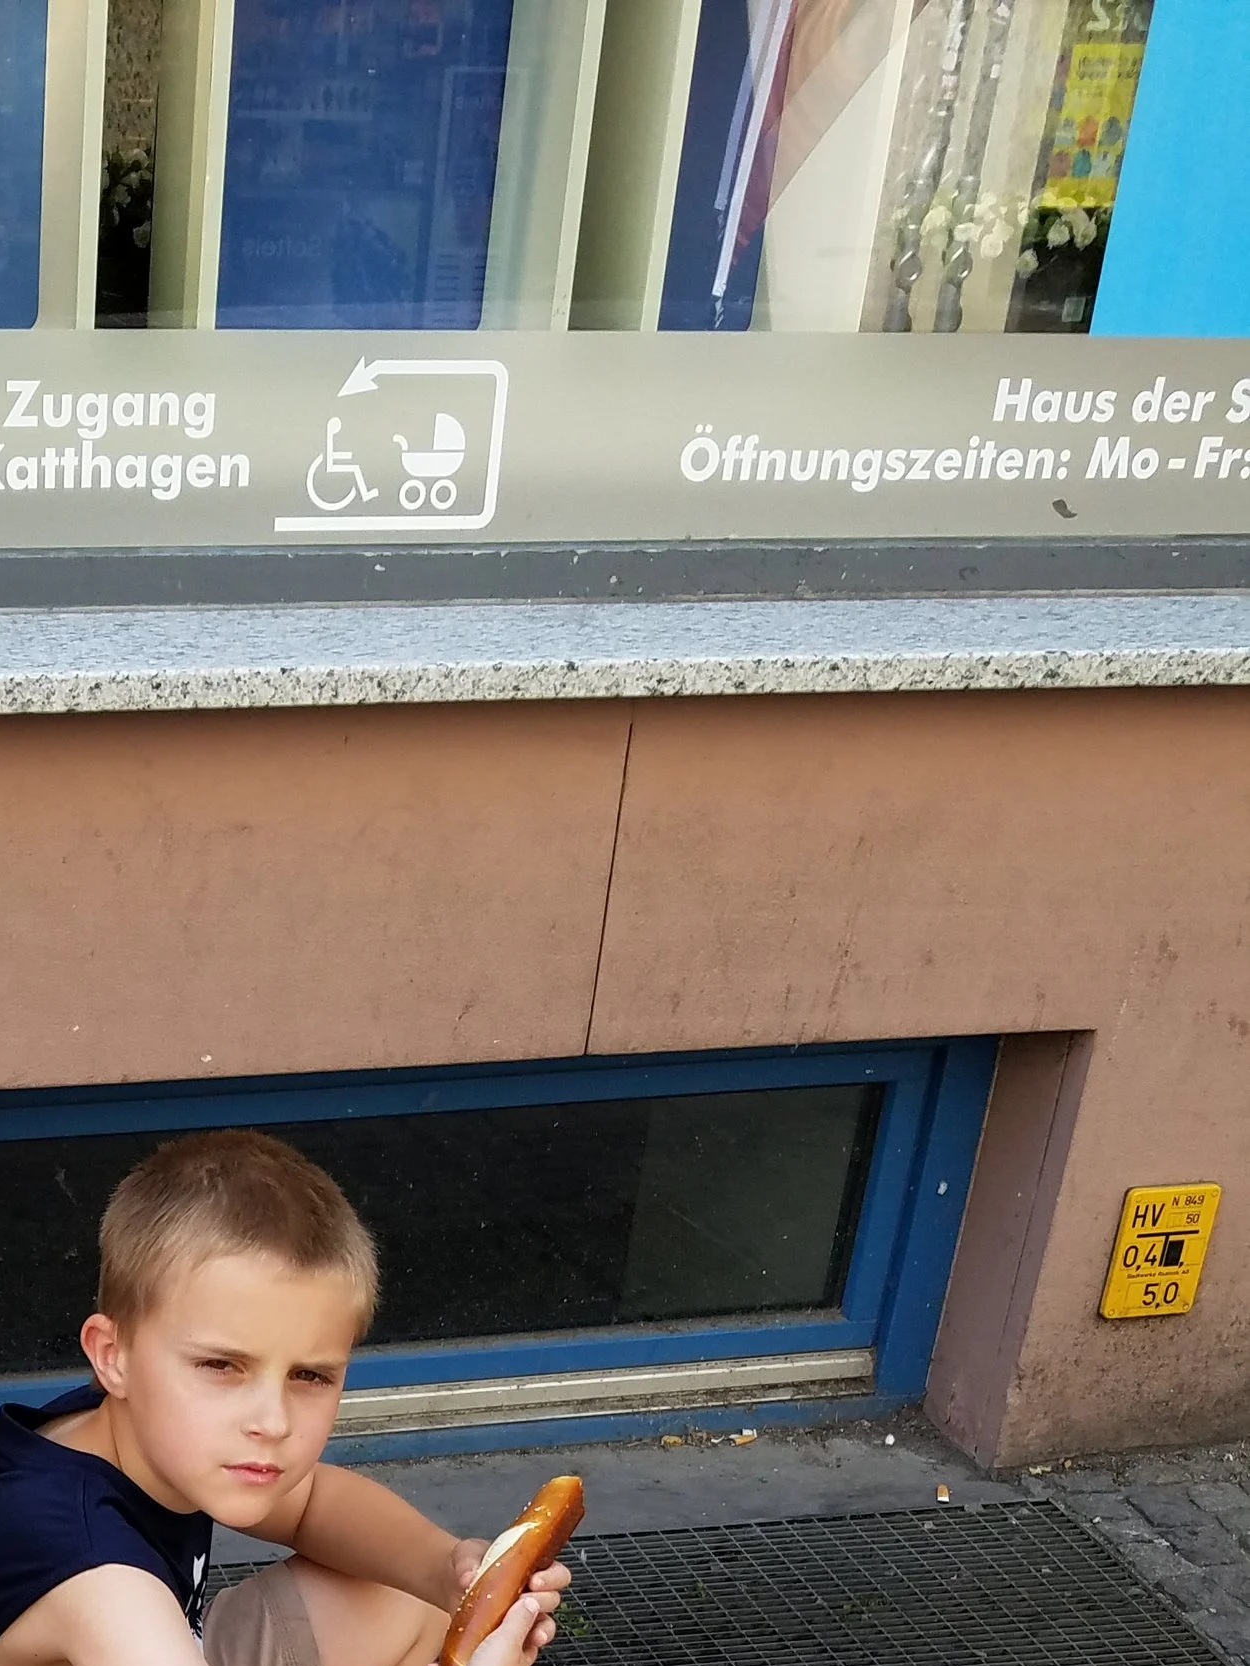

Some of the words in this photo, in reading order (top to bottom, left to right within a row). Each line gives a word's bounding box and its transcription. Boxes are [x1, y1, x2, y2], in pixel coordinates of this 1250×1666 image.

[3, 380, 216, 439] Zugang
[992, 377, 1118, 424] Haus
[1131, 376, 1216, 424] der
[680, 424, 1071, 493] Öffnungszeiten:
[1085, 436, 1159, 480] Mo
[1131, 1203, 1165, 1228] HV
[1185, 1213, 1200, 1224] 50
[1122, 1243, 1157, 1272] 0,4
[1142, 1281, 1179, 1309] 5,0
